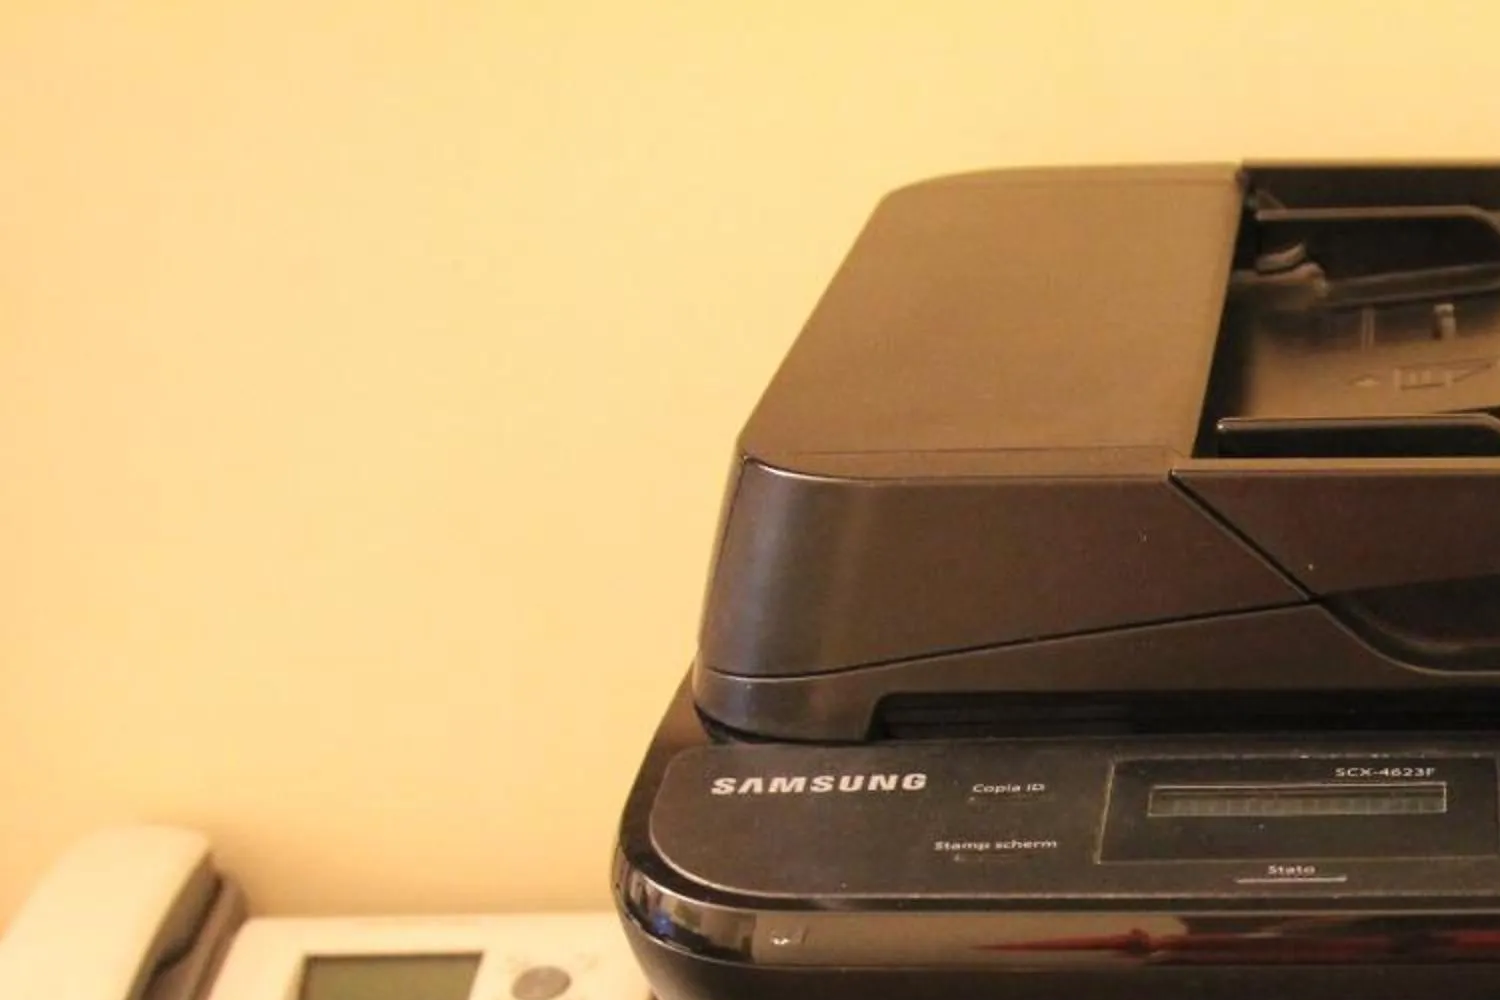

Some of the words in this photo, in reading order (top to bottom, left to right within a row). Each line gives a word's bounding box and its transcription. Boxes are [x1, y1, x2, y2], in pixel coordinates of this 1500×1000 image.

[1335, 766, 1437, 778] SCX-4623F
[711, 772, 928, 796] SAMSUNG
[972, 783, 1021, 793] Copia
[1267, 864, 1317, 876] Stato
